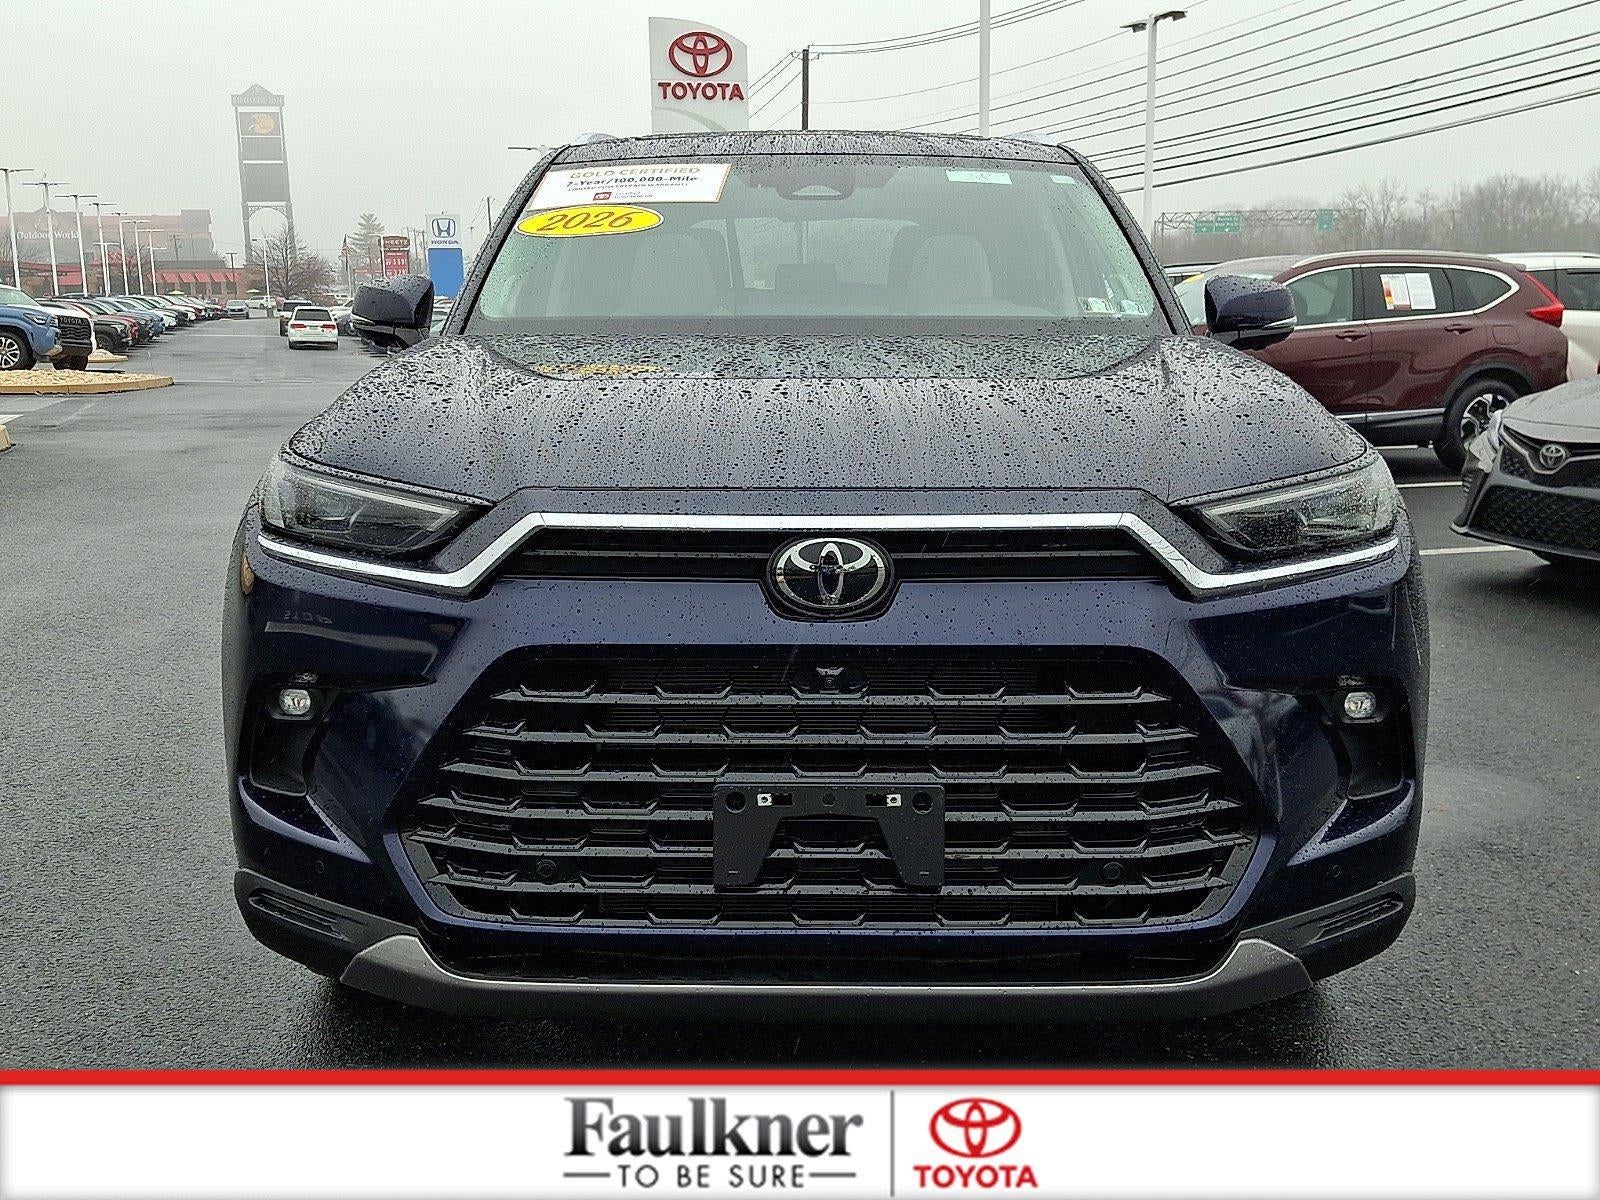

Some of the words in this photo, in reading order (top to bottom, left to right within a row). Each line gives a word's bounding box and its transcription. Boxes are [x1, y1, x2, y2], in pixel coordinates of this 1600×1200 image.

[658, 82, 744, 101] TOYOTA
[570, 171, 615, 179] GOLD
[619, 167, 701, 176] CERTIFIED
[536, 211, 643, 232] 2026
[59, 317, 82, 325] TOYOTA
